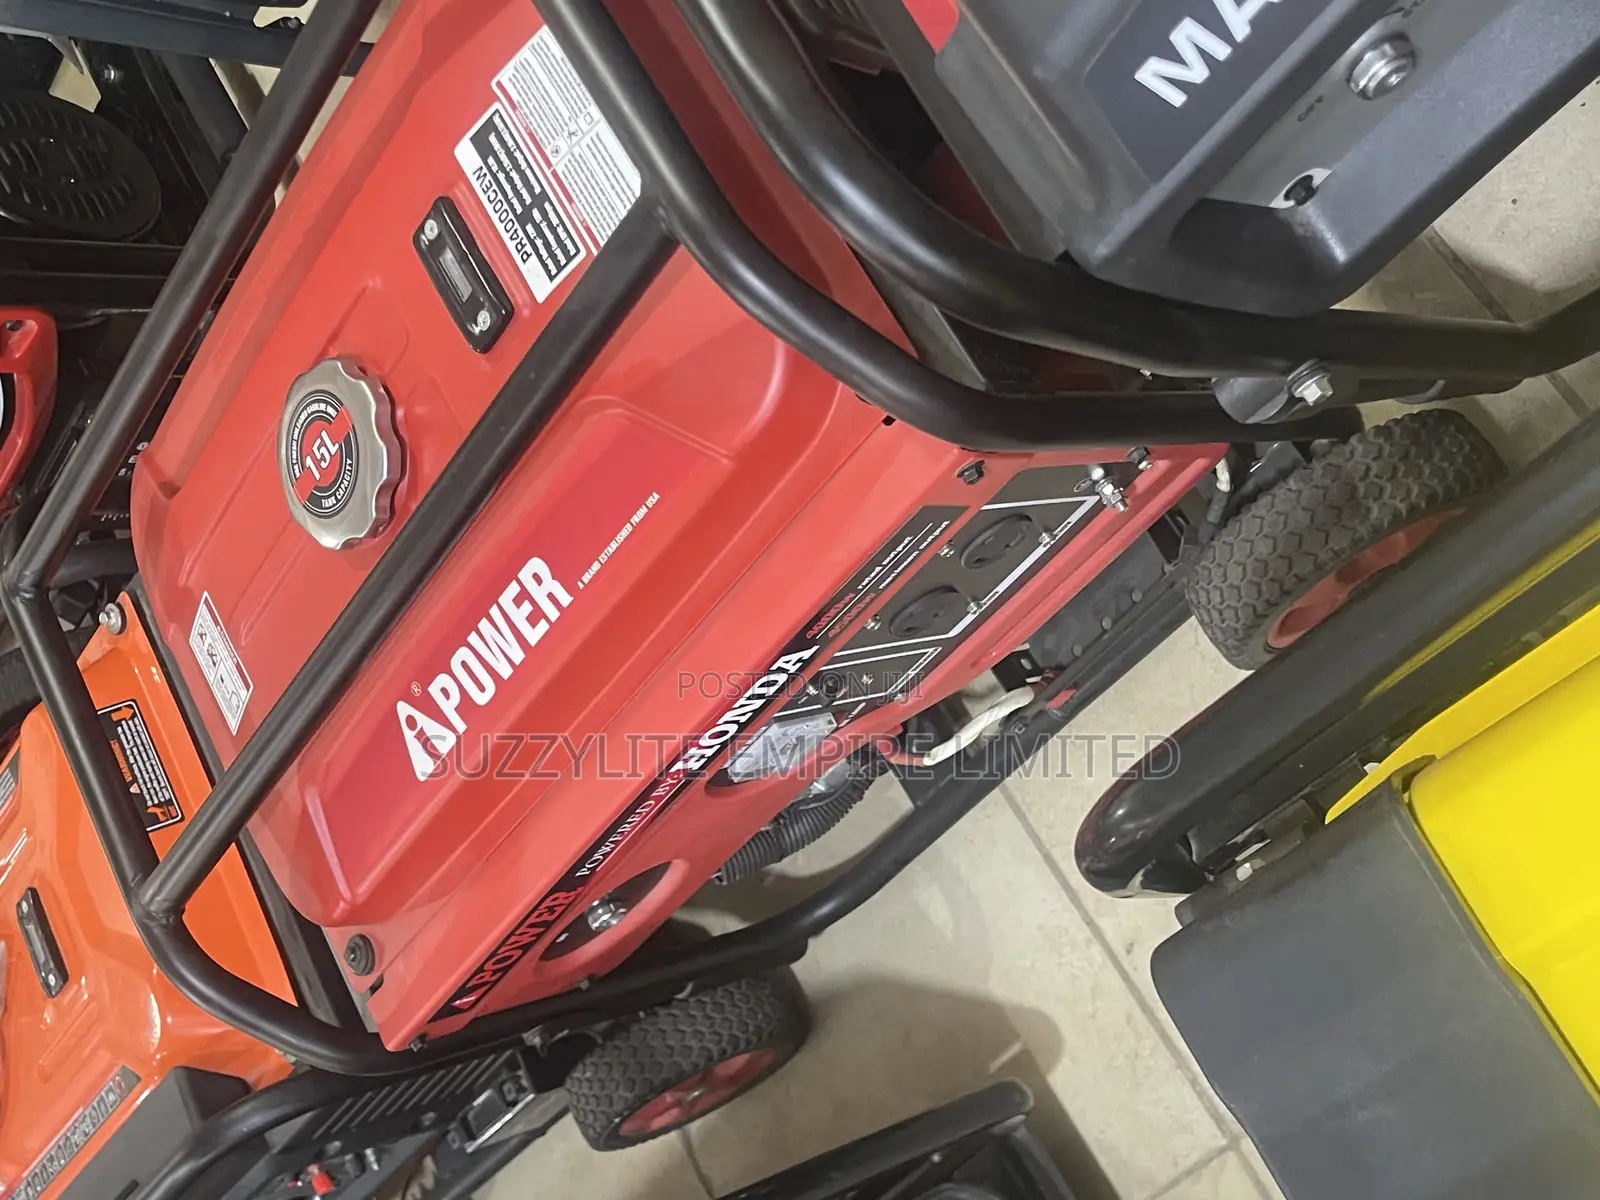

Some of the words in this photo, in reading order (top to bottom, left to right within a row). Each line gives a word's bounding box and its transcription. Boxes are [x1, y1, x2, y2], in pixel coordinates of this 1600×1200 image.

[473, 165, 532, 264] PR4000CEW
[305, 429, 339, 480] 15L
[335, 458, 353, 500] CAPACITY
[581, 560, 601, 585] BRAND
[598, 522, 633, 564] ESTABLISHED
[630, 504, 649, 527] FROM
[644, 491, 661, 508] USA
[575, 799, 657, 877] POWERED
[669, 645, 820, 772] HONDA
